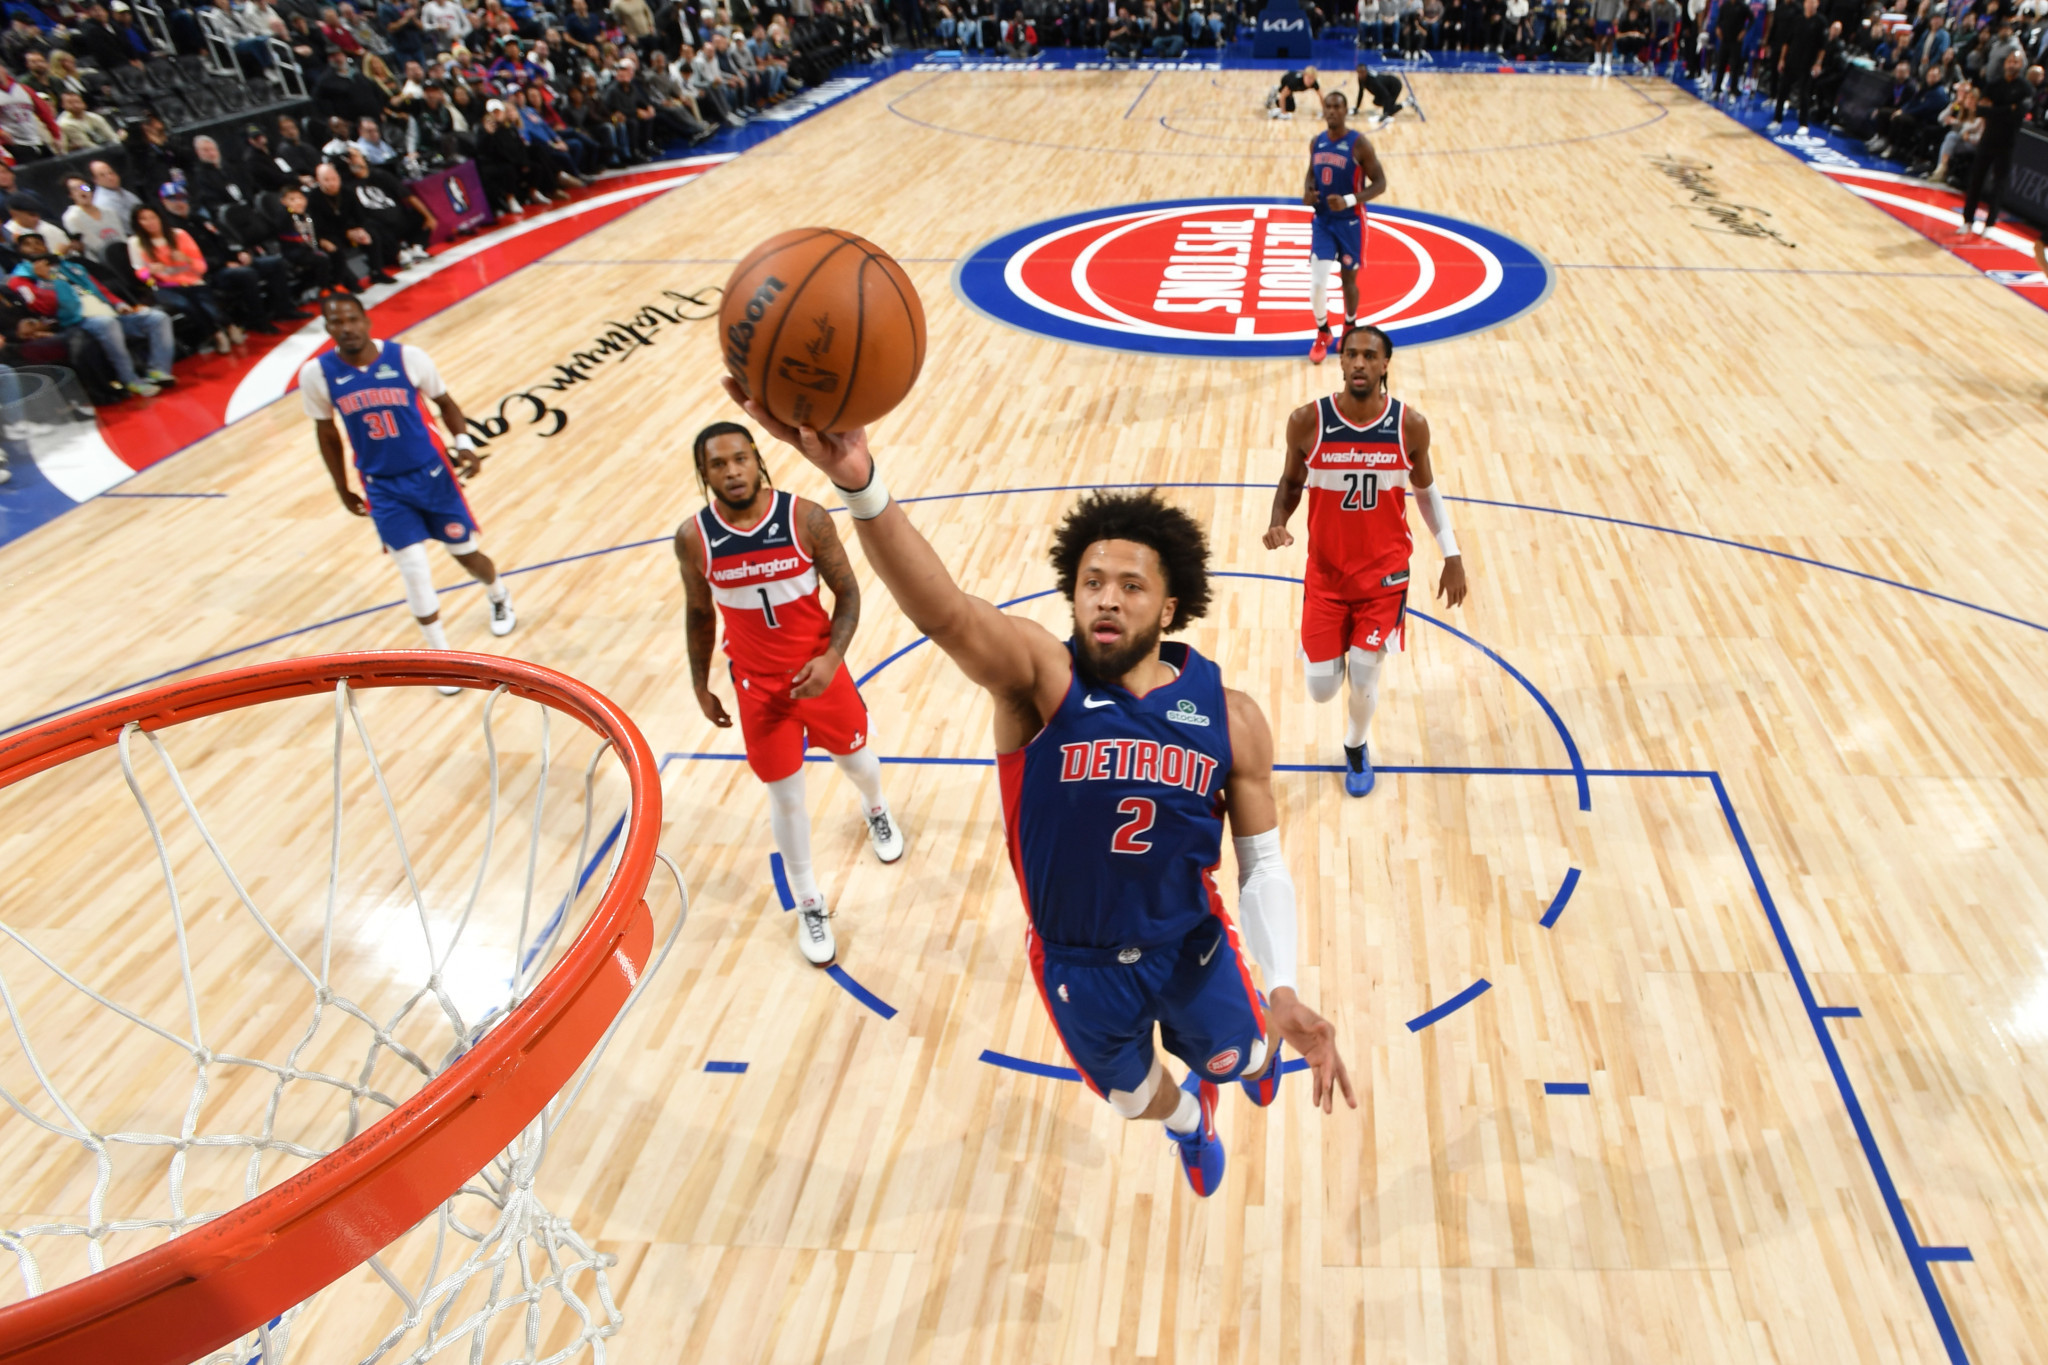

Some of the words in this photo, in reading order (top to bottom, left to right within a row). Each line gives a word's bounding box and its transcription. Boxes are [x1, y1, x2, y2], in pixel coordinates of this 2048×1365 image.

[1321, 166, 1333, 186] 0
[1152, 219, 1256, 315] PISTONS
[336, 386, 410, 416] DETROIT
[362, 409, 401, 441] 31
[1321, 447, 1398, 467] washington
[1341, 473, 1378, 511] 20
[712, 556, 799, 583] washington
[756, 587, 781, 629] 1
[1059, 738, 1219, 797] DETROIT
[1110, 796, 1157, 855] 2
